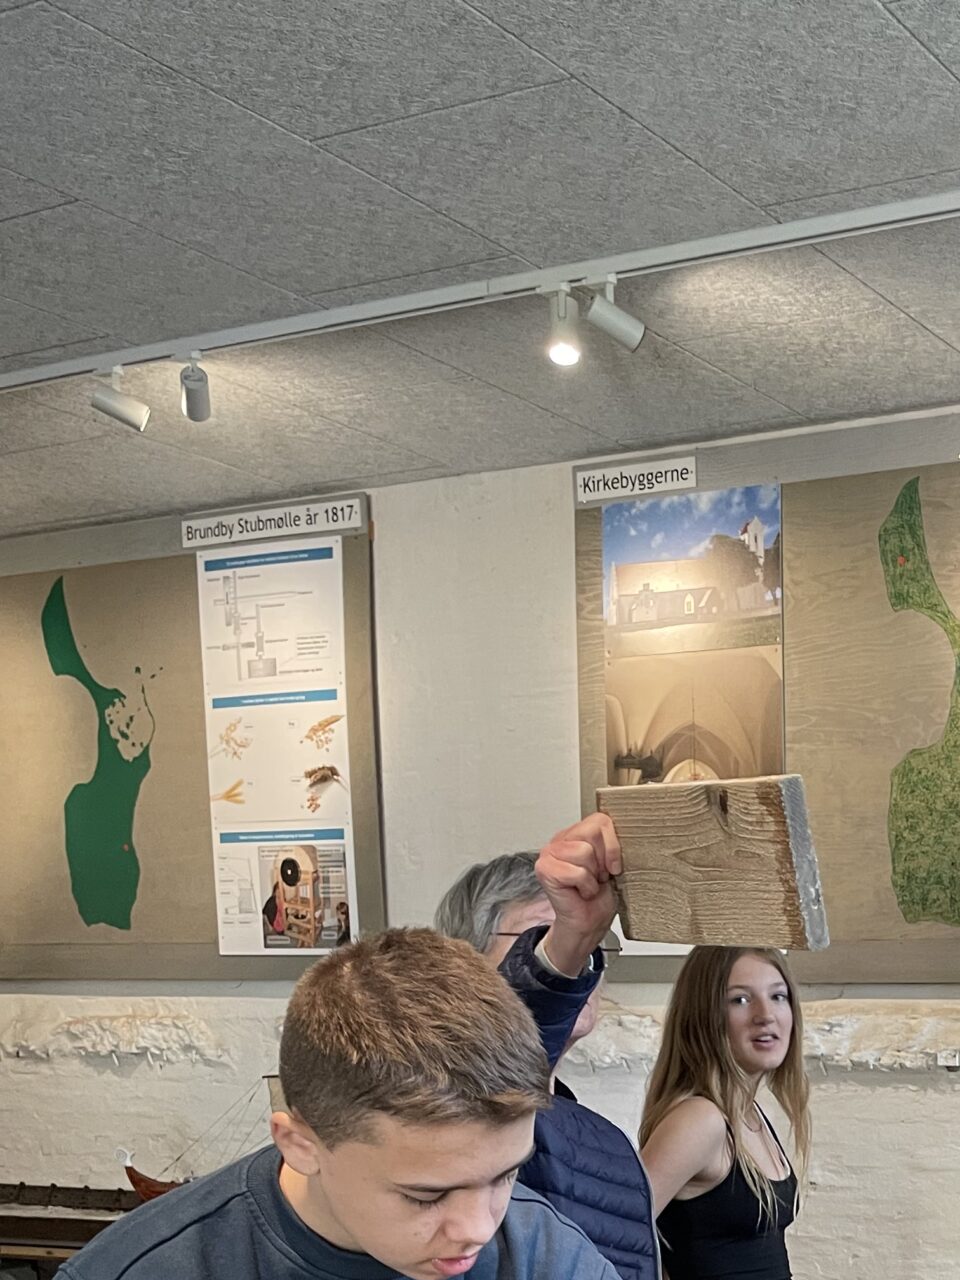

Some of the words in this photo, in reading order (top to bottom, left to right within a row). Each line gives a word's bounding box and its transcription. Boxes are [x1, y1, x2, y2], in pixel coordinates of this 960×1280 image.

[583, 467, 689, 494] Kirkebyggerne
[186, 521, 235, 541] Brundby
[238, 511, 301, 534] Stubmølle
[306, 507, 319, 526] år
[325, 504, 354, 523] 1817
